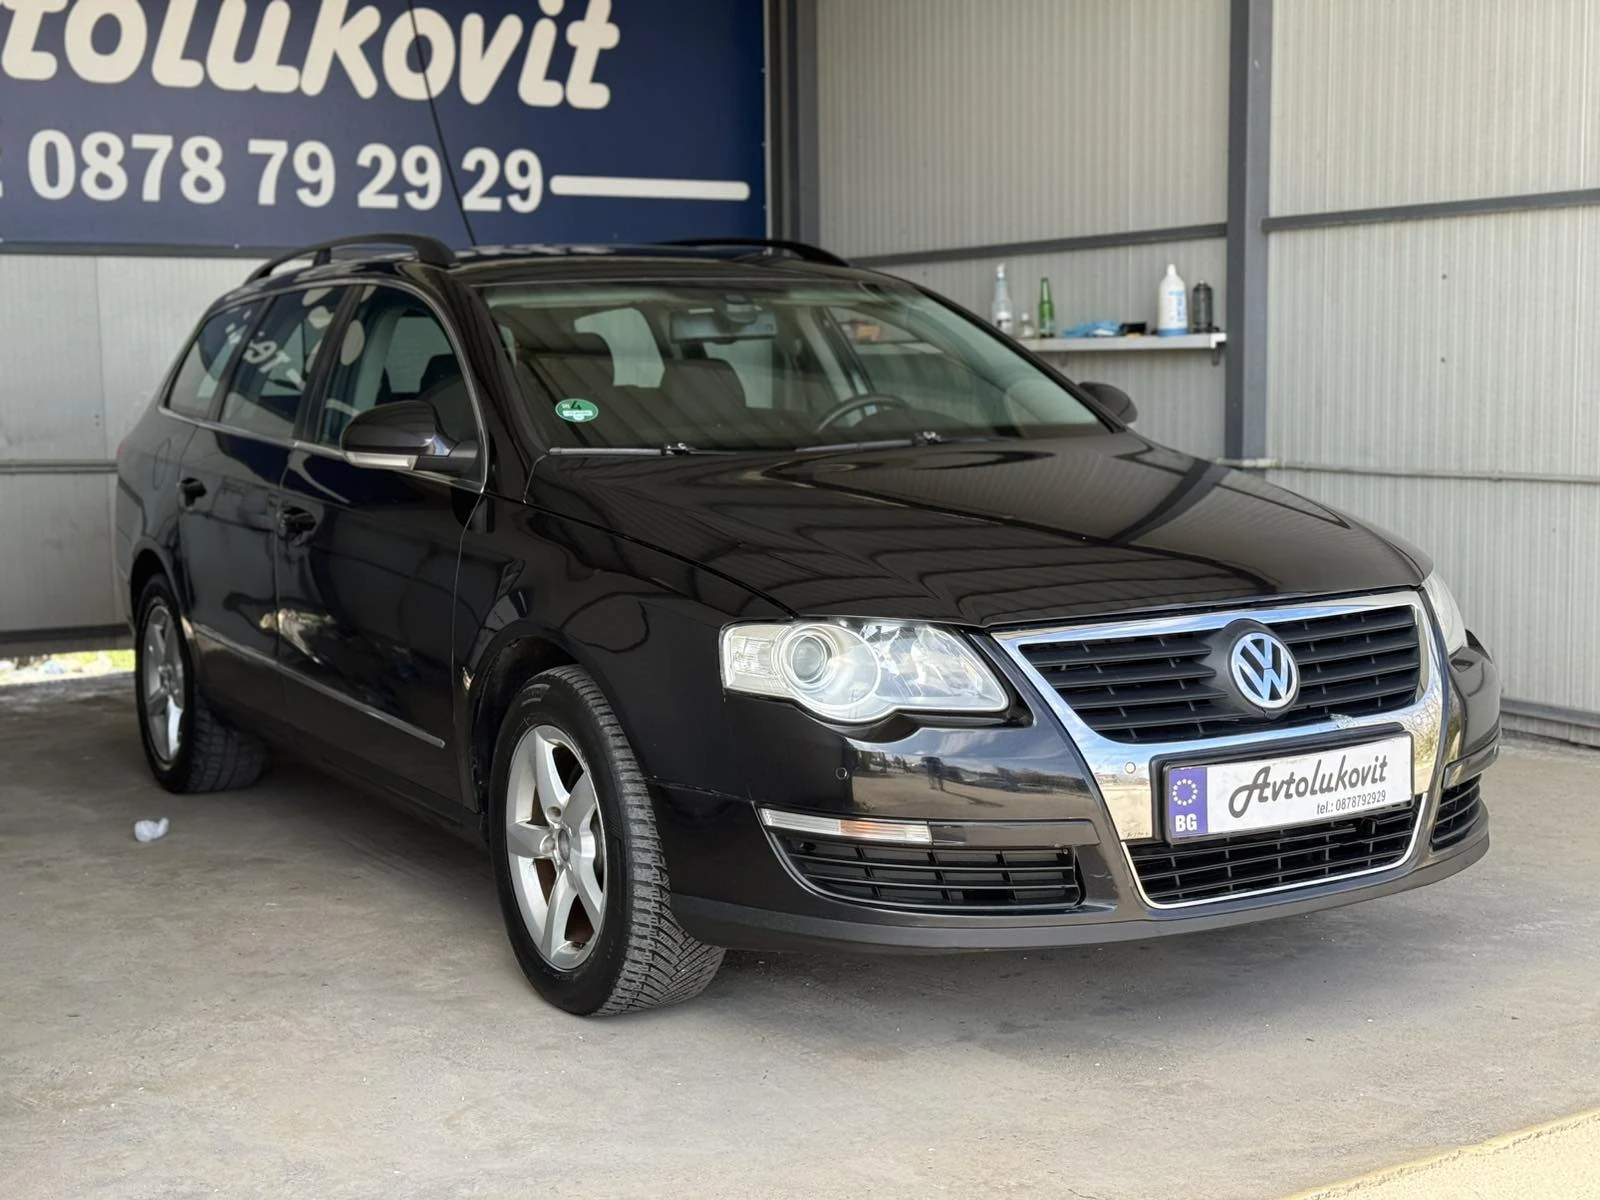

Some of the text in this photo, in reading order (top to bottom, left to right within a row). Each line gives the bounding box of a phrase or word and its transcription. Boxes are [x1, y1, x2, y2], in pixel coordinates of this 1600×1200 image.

[28, 129, 543, 213] 0878 79 29 29
[1232, 633, 1296, 708] VW
[1228, 754, 1388, 818] Avtolukovit
[1335, 789, 1386, 812] 0878792929
[1175, 813, 1198, 832] BG
